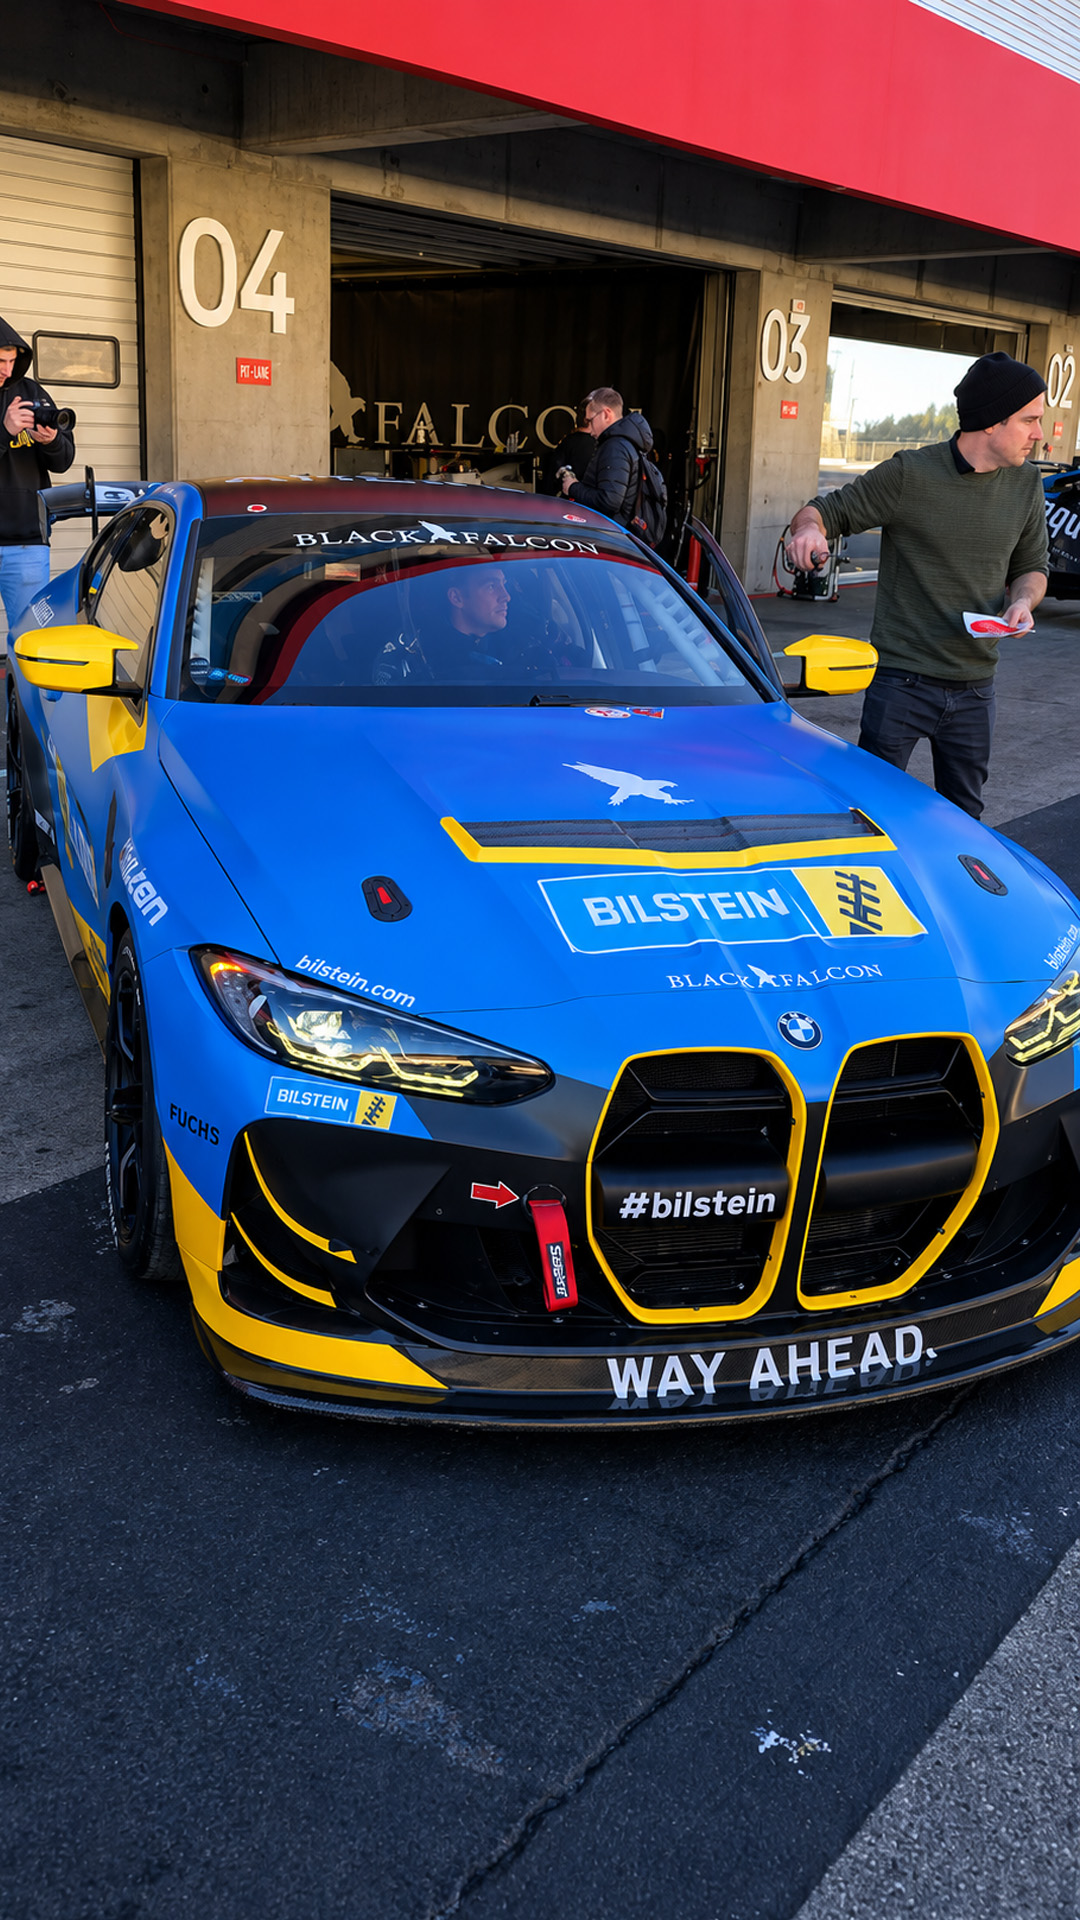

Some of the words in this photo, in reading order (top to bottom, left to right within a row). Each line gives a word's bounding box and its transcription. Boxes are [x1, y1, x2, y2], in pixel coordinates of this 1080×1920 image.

[179, 217, 295, 335] 04
[761, 308, 811, 384] 03
[1047, 353, 1076, 409] 02
[374, 402, 643, 449] FALCO
[293, 530, 426, 547] BLACK
[460, 530, 600, 555] FALCON
[582, 888, 790, 927] BILSTEIN
[295, 954, 416, 1008] bilstein.com
[666, 971, 755, 989] BLACK
[779, 964, 884, 987] FALCON
[277, 1088, 349, 1112] BILSTEIN
[170, 1103, 220, 1146] FUCHS
[619, 1187, 776, 1219] #bilstein
[607, 1352, 726, 1399] WAY
[750, 1325, 938, 1389] AHEAD.
